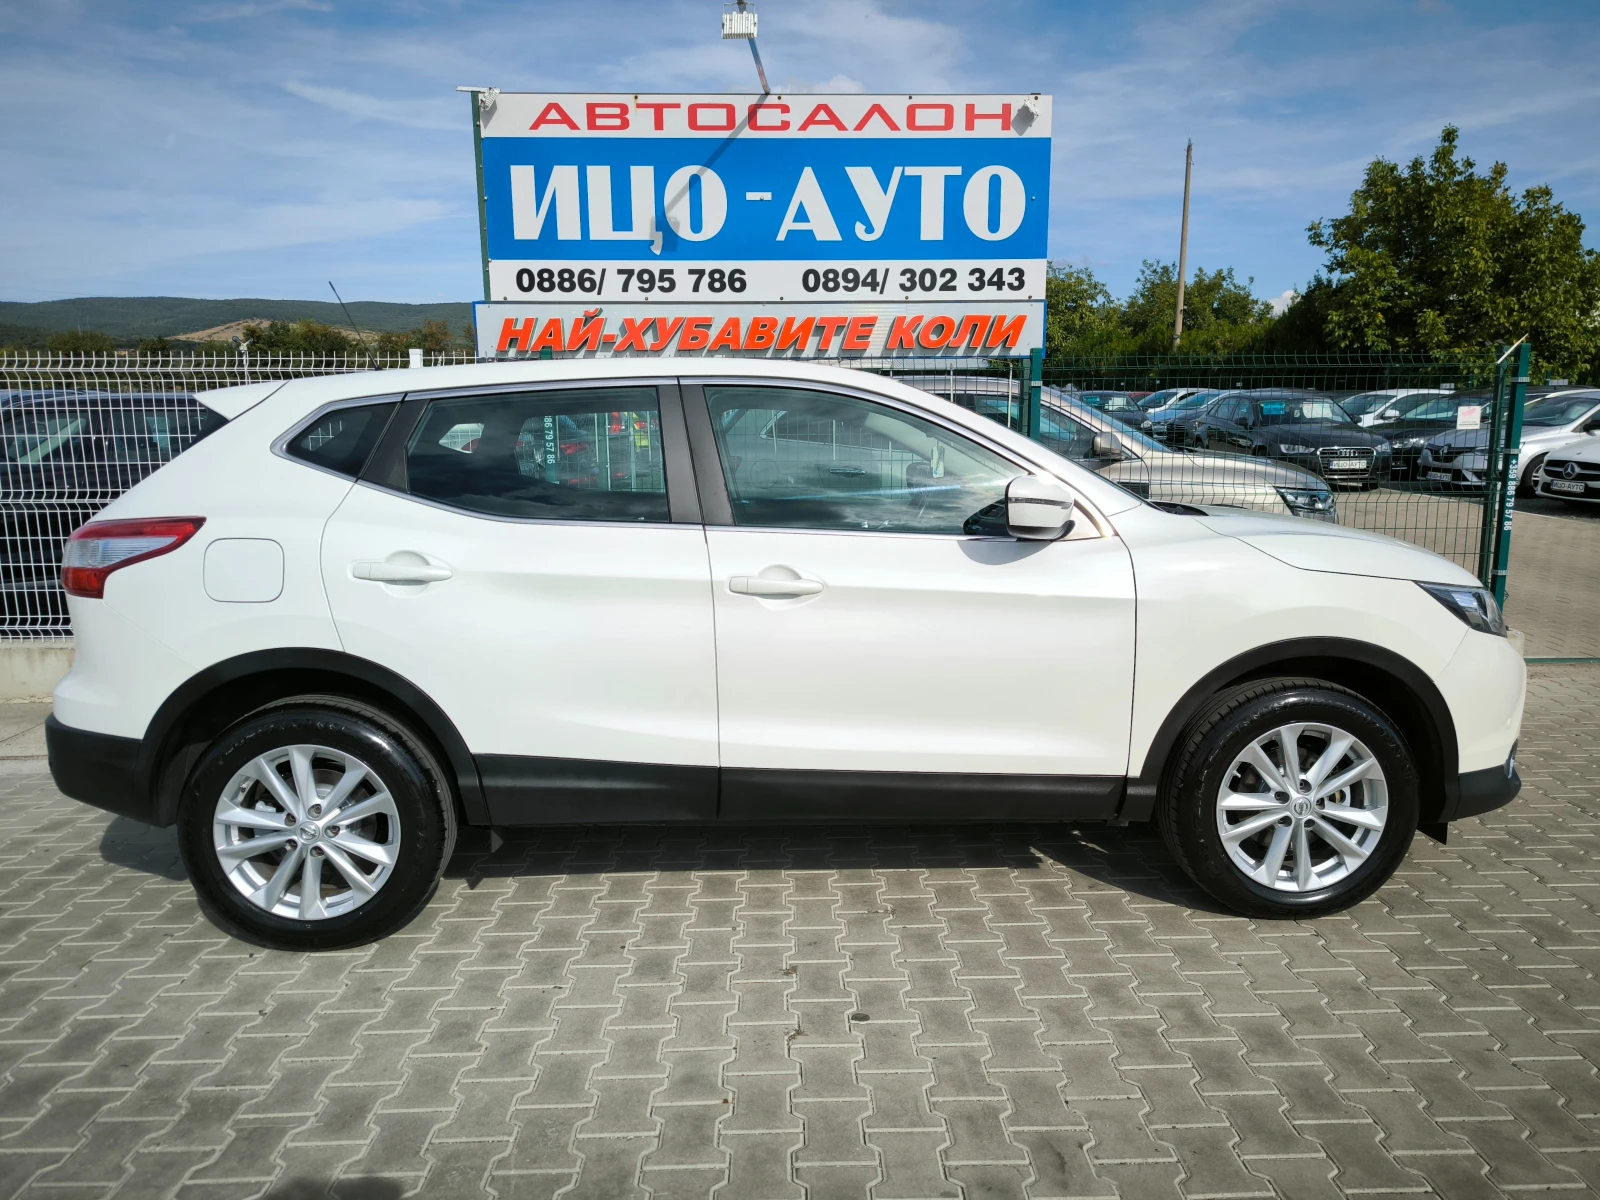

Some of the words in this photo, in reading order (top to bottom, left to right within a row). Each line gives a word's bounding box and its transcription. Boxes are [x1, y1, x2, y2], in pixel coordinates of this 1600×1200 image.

[529, 102, 1013, 132] АВТОСАЛОН
[515, 267, 607, 295] 0886/
[616, 268, 677, 293] 795
[687, 268, 747, 293] 786
[801, 267, 890, 295] 0894/
[898, 267, 958, 293] 302
[967, 267, 1026, 292] 343
[496, 307, 879, 352] НАЙ-ХУБАВИТЕ
[887, 314, 1027, 349] КОЛИ
[544, 415, 553, 428] 86
[545, 429, 554, 440] 79
[545, 442, 555, 452] 57
[546, 454, 556, 465] 86
[1508, 459, 1518, 479] +359
[1506, 480, 1516, 496] 886
[1505, 497, 1515, 507] 79
[1504, 509, 1513, 519] 57
[1503, 521, 1513, 531] 86
